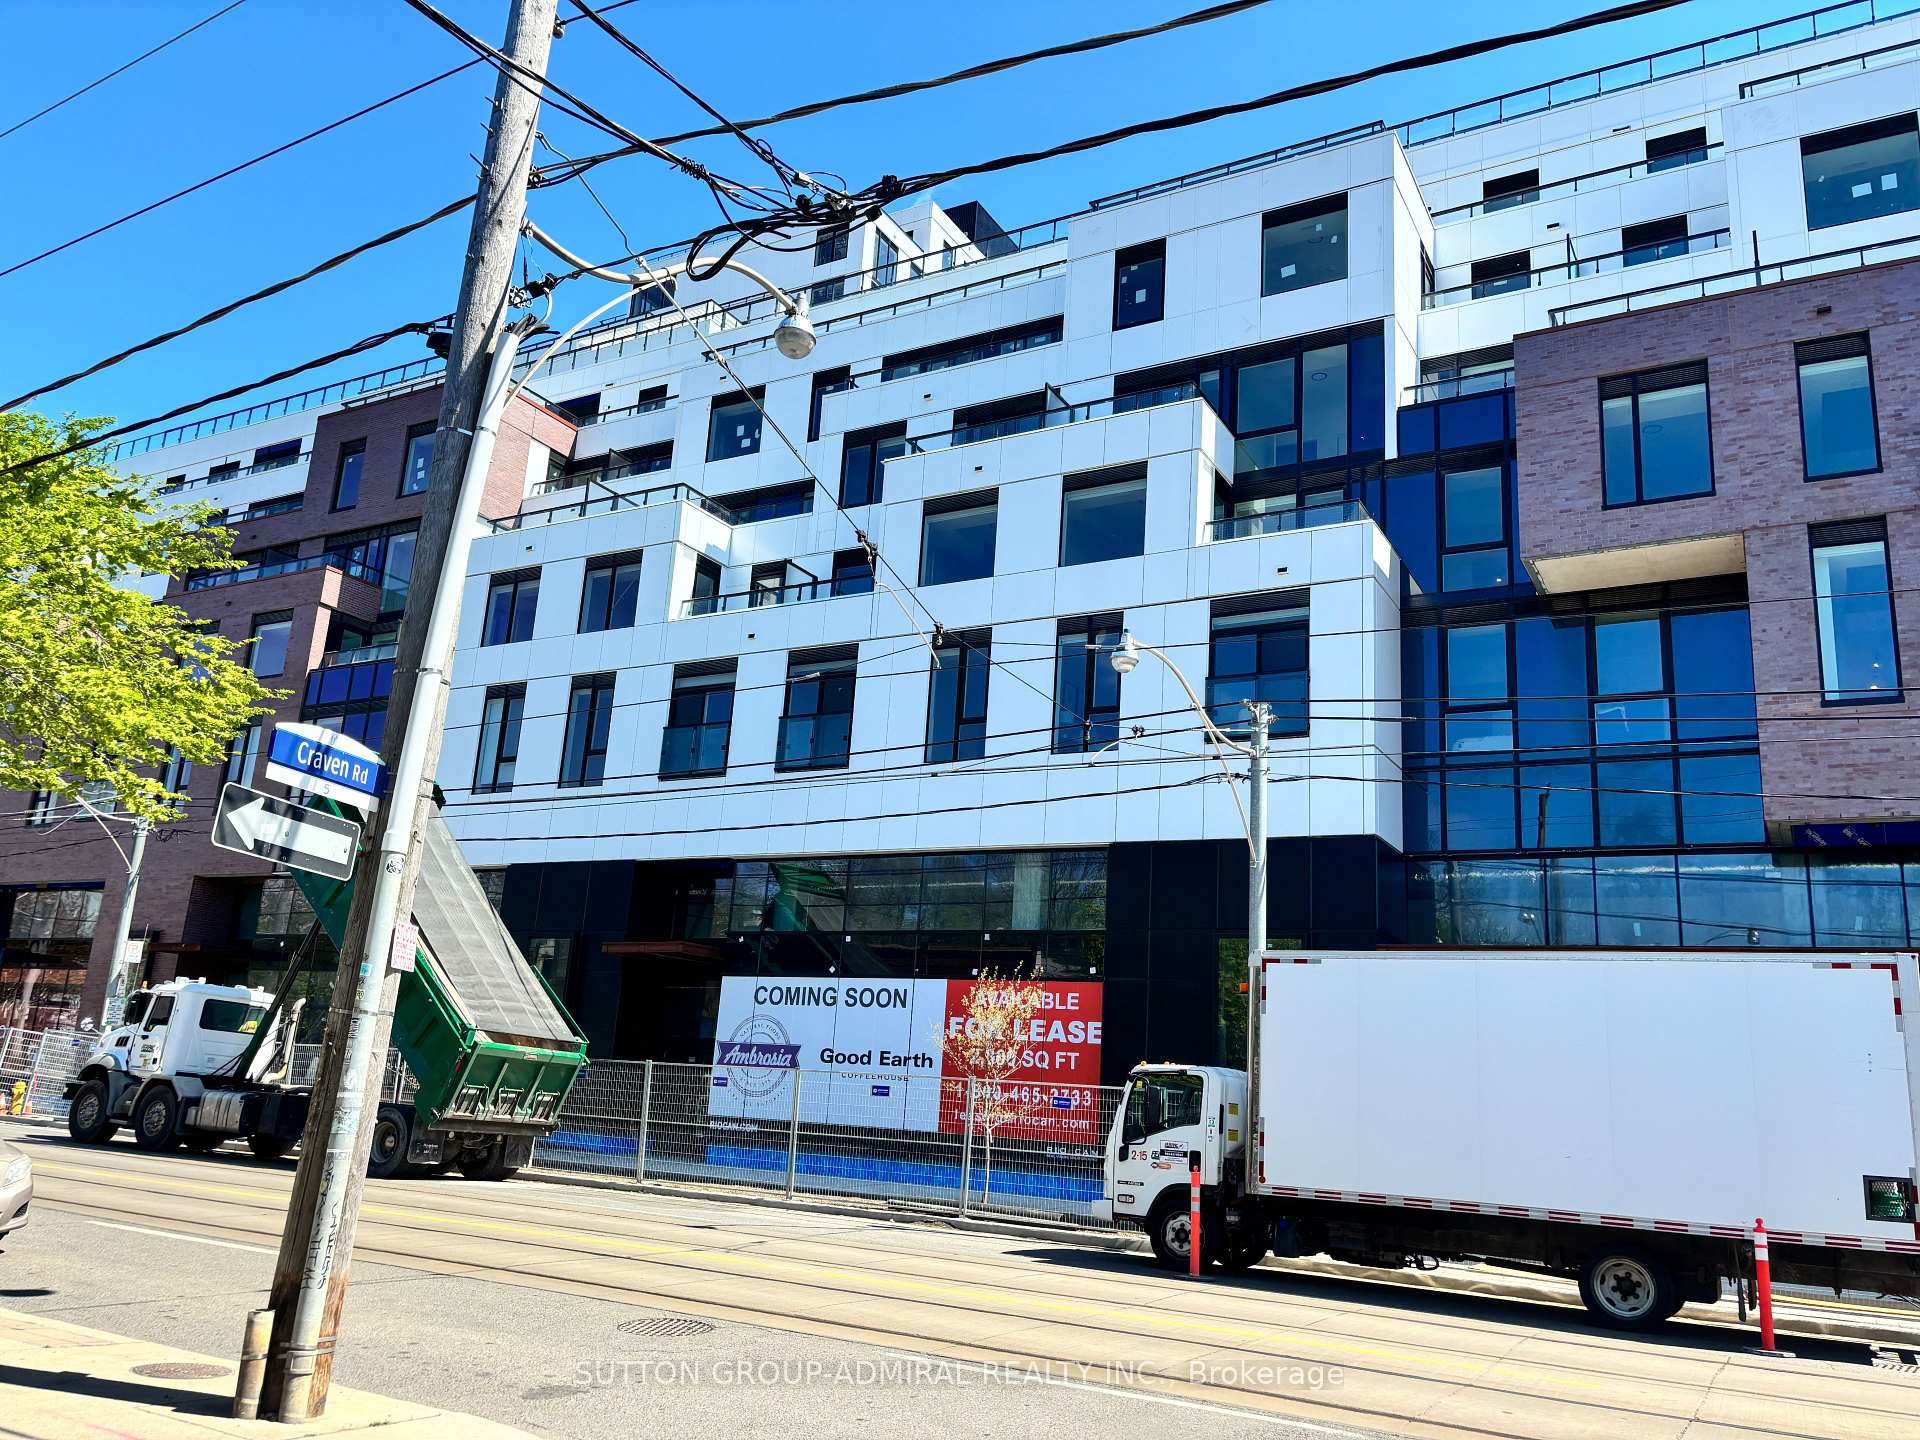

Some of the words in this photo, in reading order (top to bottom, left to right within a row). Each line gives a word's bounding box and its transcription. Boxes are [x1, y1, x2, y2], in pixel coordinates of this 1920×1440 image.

[297, 741, 349, 778] Craven
[352, 764, 369, 784] Rd
[754, 985, 837, 1007] COMING
[845, 987, 908, 1009] SOON
[1013, 1018, 1103, 1044] LEASE
[724, 1044, 792, 1067] Ambrosia
[820, 1048, 872, 1066] Good
[879, 1050, 933, 1069] Earth
[1022, 1050, 1050, 1069] SQ
[1055, 1051, 1080, 1070] FT
[841, 1073, 909, 1082] COFFEEHOUSE
[1131, 1150, 1148, 1161] 2-15
